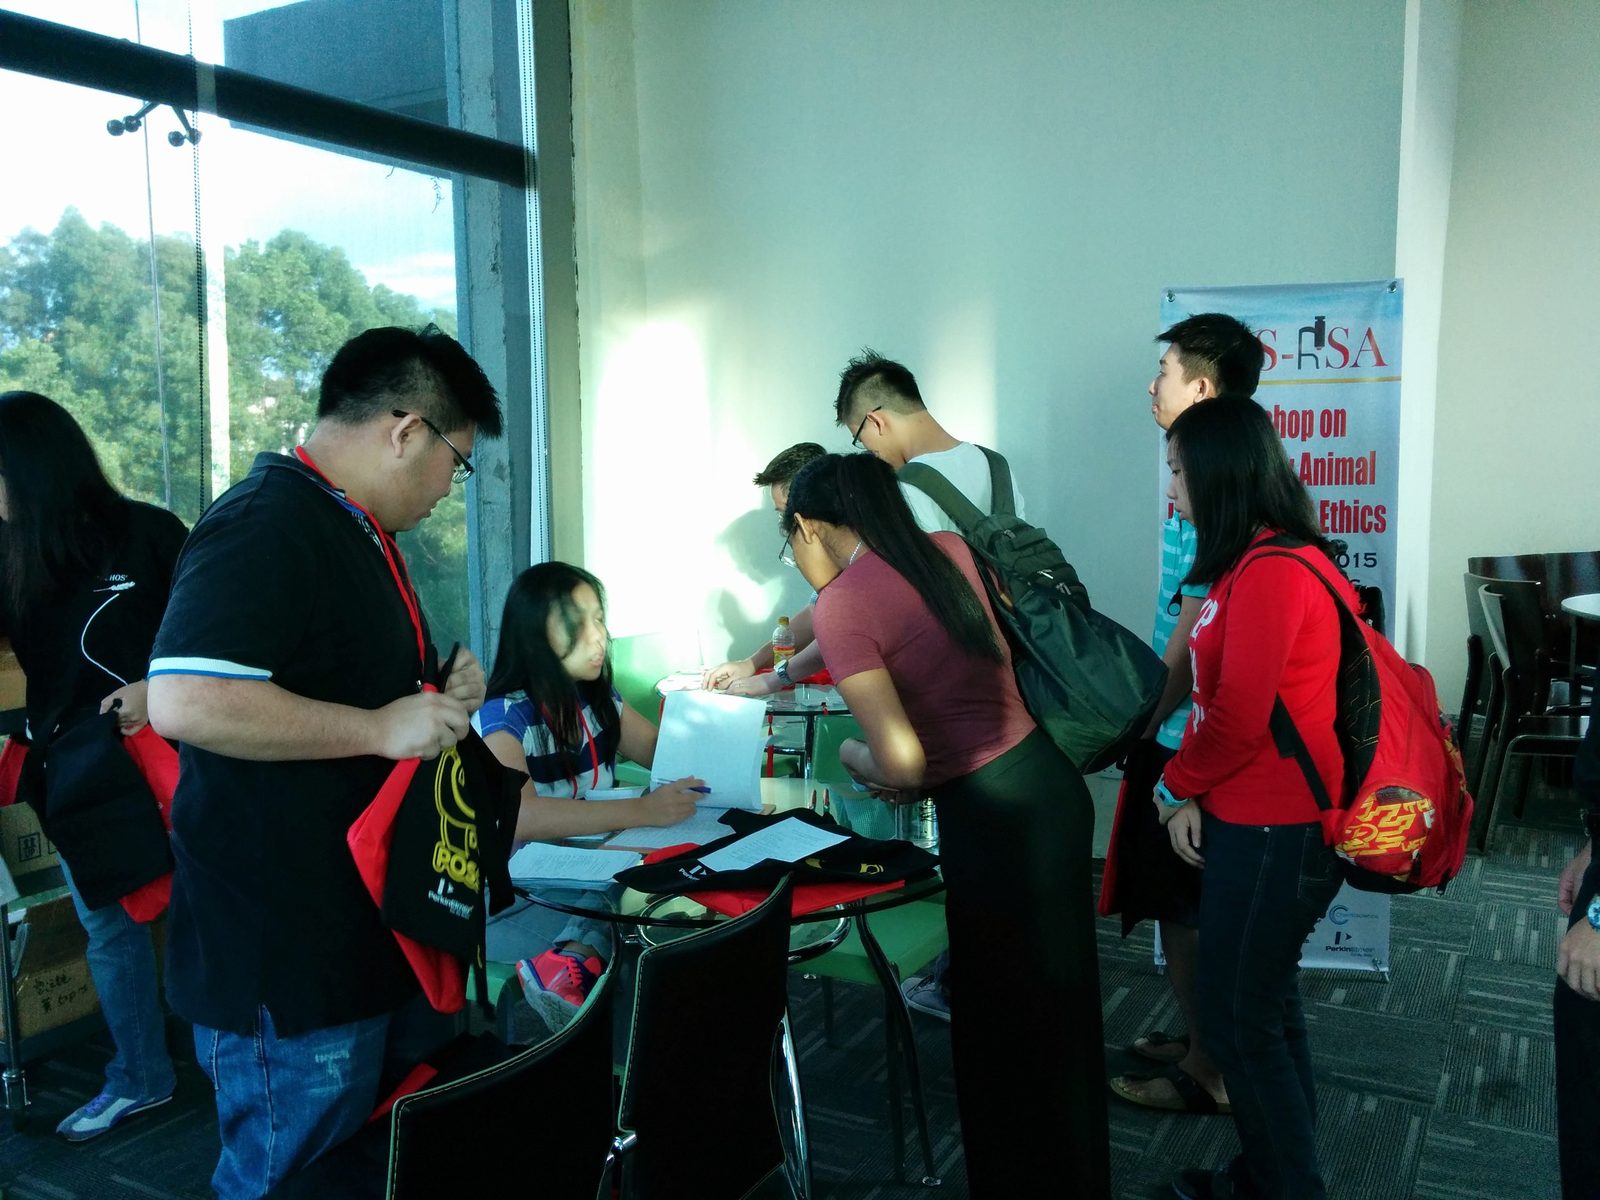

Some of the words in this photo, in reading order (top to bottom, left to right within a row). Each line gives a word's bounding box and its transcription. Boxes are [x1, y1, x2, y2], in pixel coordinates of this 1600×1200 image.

[1319, 407, 1347, 438] on
[1299, 450, 1376, 487] Animal
[1319, 500, 1387, 534] Ethics
[1337, 552, 1378, 568] 015
